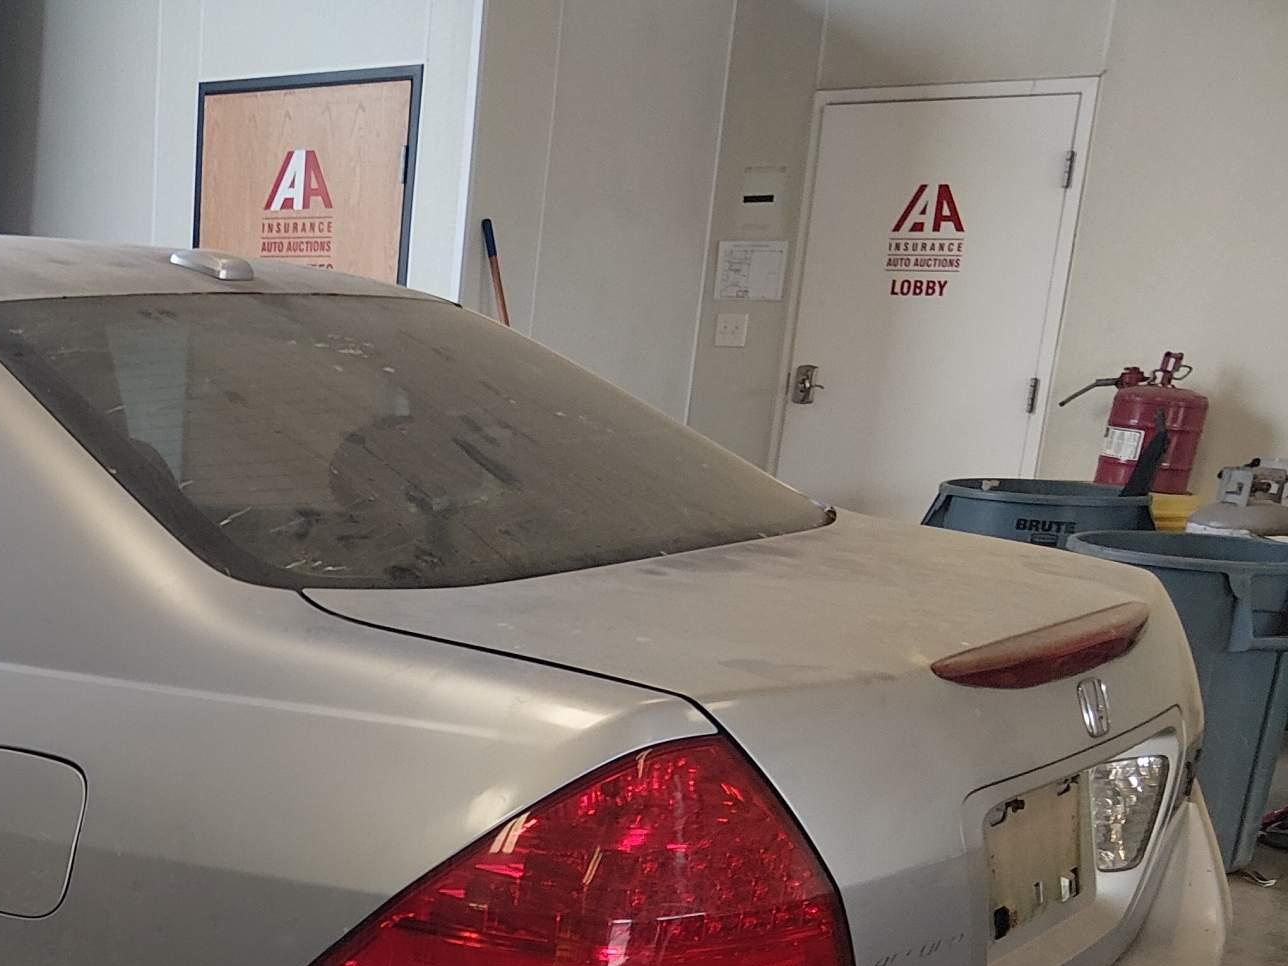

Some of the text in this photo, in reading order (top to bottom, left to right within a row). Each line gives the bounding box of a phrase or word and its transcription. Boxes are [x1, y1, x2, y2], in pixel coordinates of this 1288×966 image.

[261, 221, 333, 233] INSURANCE
[261, 240, 332, 253] AUTO AUCTIONS
[888, 241, 964, 252] INSURANCE
[886, 257, 961, 269] AUTO AUCTIONS
[890, 279, 948, 297] LOBBY
[1015, 518, 1078, 534] BRUTE
